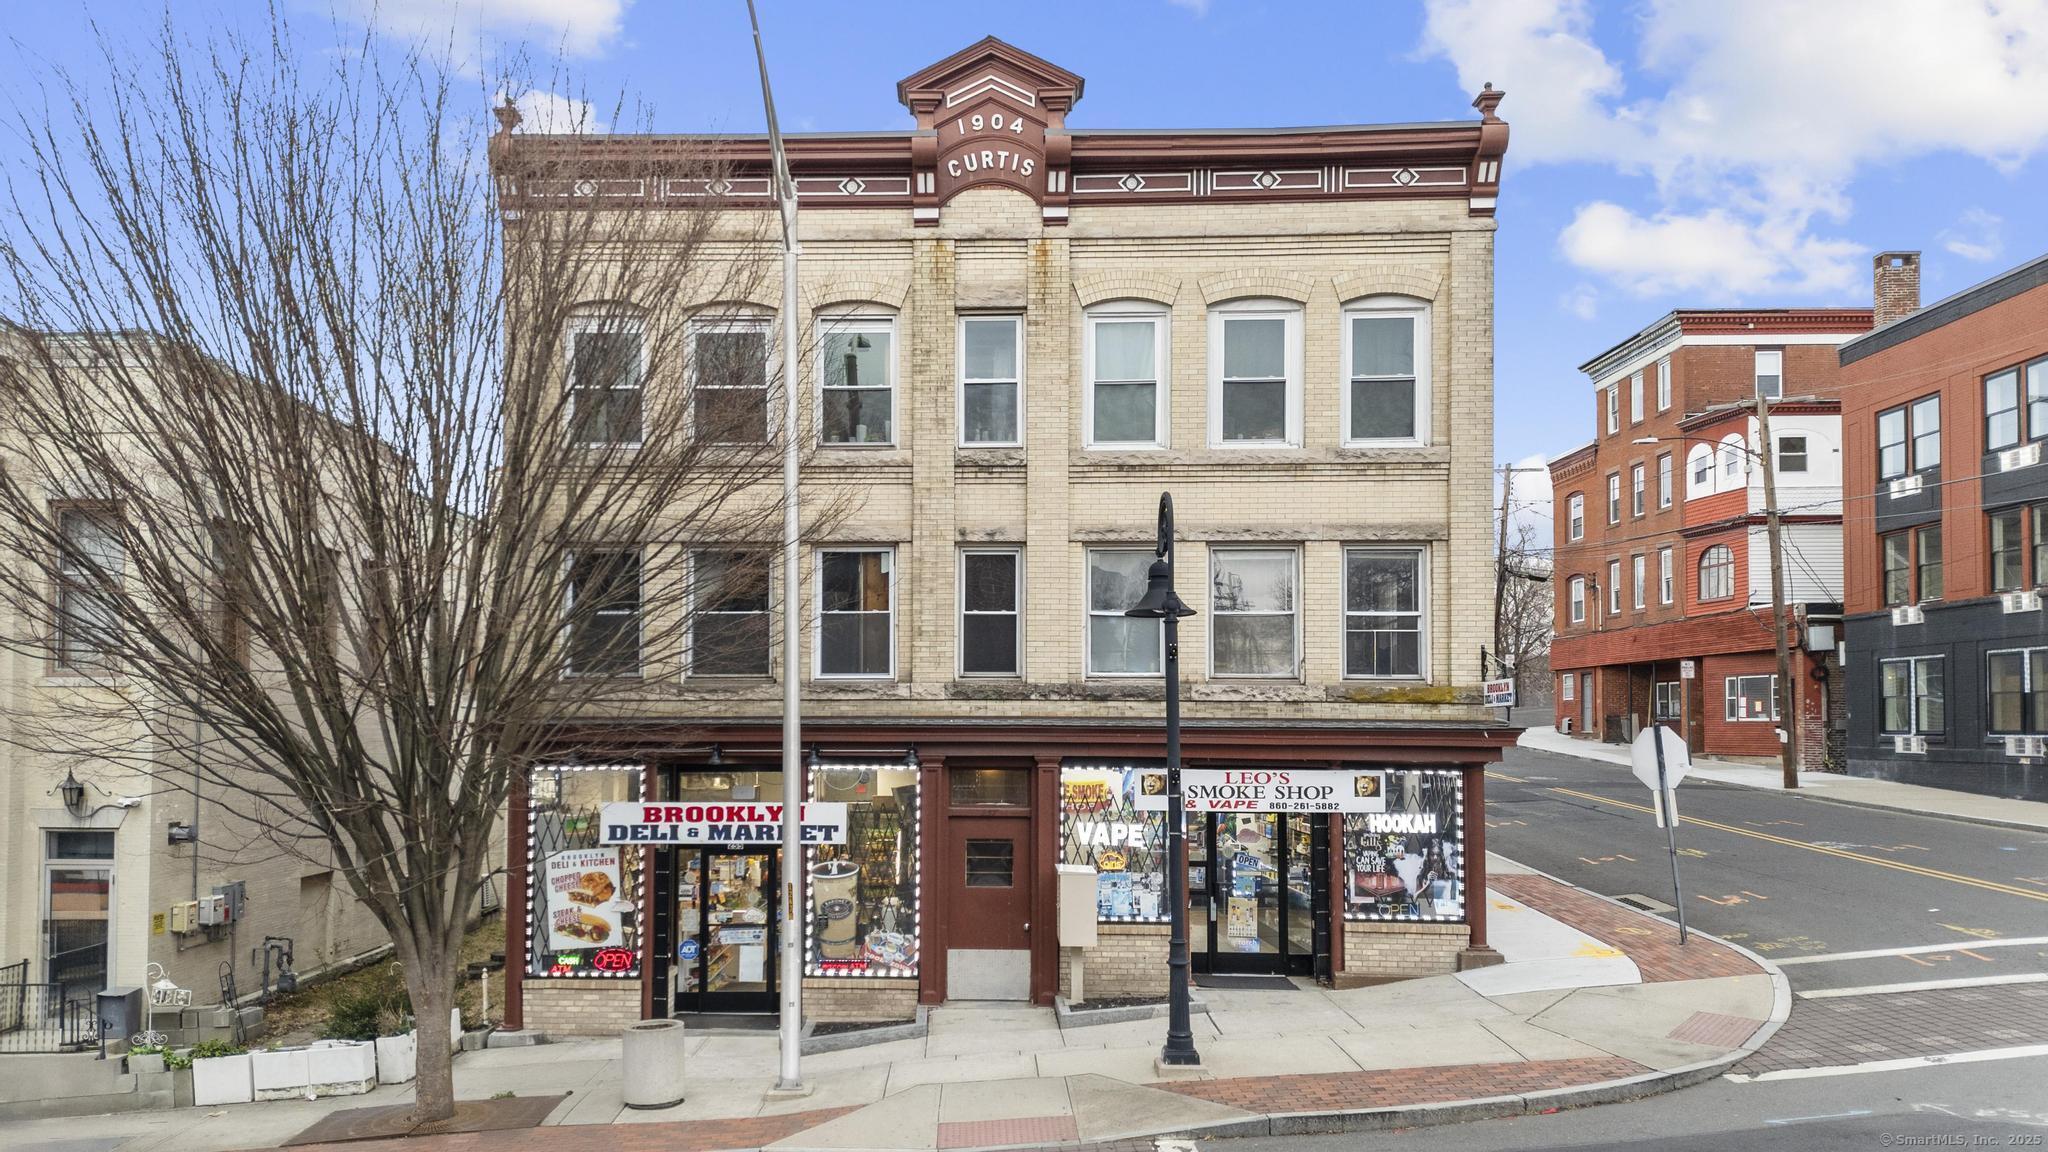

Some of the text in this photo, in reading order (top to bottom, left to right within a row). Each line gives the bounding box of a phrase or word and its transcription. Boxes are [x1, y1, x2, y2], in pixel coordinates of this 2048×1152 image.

[957, 113, 1024, 134] 1904
[947, 150, 1035, 177] CURTIS
[1487, 682, 1510, 694] BROOKLYN
[1224, 771, 1290, 785] LEO'S
[1072, 783, 1105, 800] SMOKE
[1187, 785, 1334, 800] SMOKE SHOP
[1185, 800, 1340, 810] & VAPE 860-261-5882
[1369, 813, 1436, 834] HOOKAH
[608, 825, 679, 841] DELI
[687, 829, 699, 838] &
[1076, 821, 1147, 850] VAPE
[551, 861, 569, 869] DELI
[580, 858, 616, 867] KITCHEN
[1238, 856, 1259, 867] OPEN
[1356, 856, 1370, 865] CAN
[1373, 864, 1385, 873] LIFE
[551, 872, 581, 886] CHOPPED
[552, 909, 574, 919] STEAK
[1378, 904, 1419, 917] OPEN
[681, 946, 696, 954] ADT
[596, 952, 632, 967] OPEN
[551, 964, 572, 972] ATM
